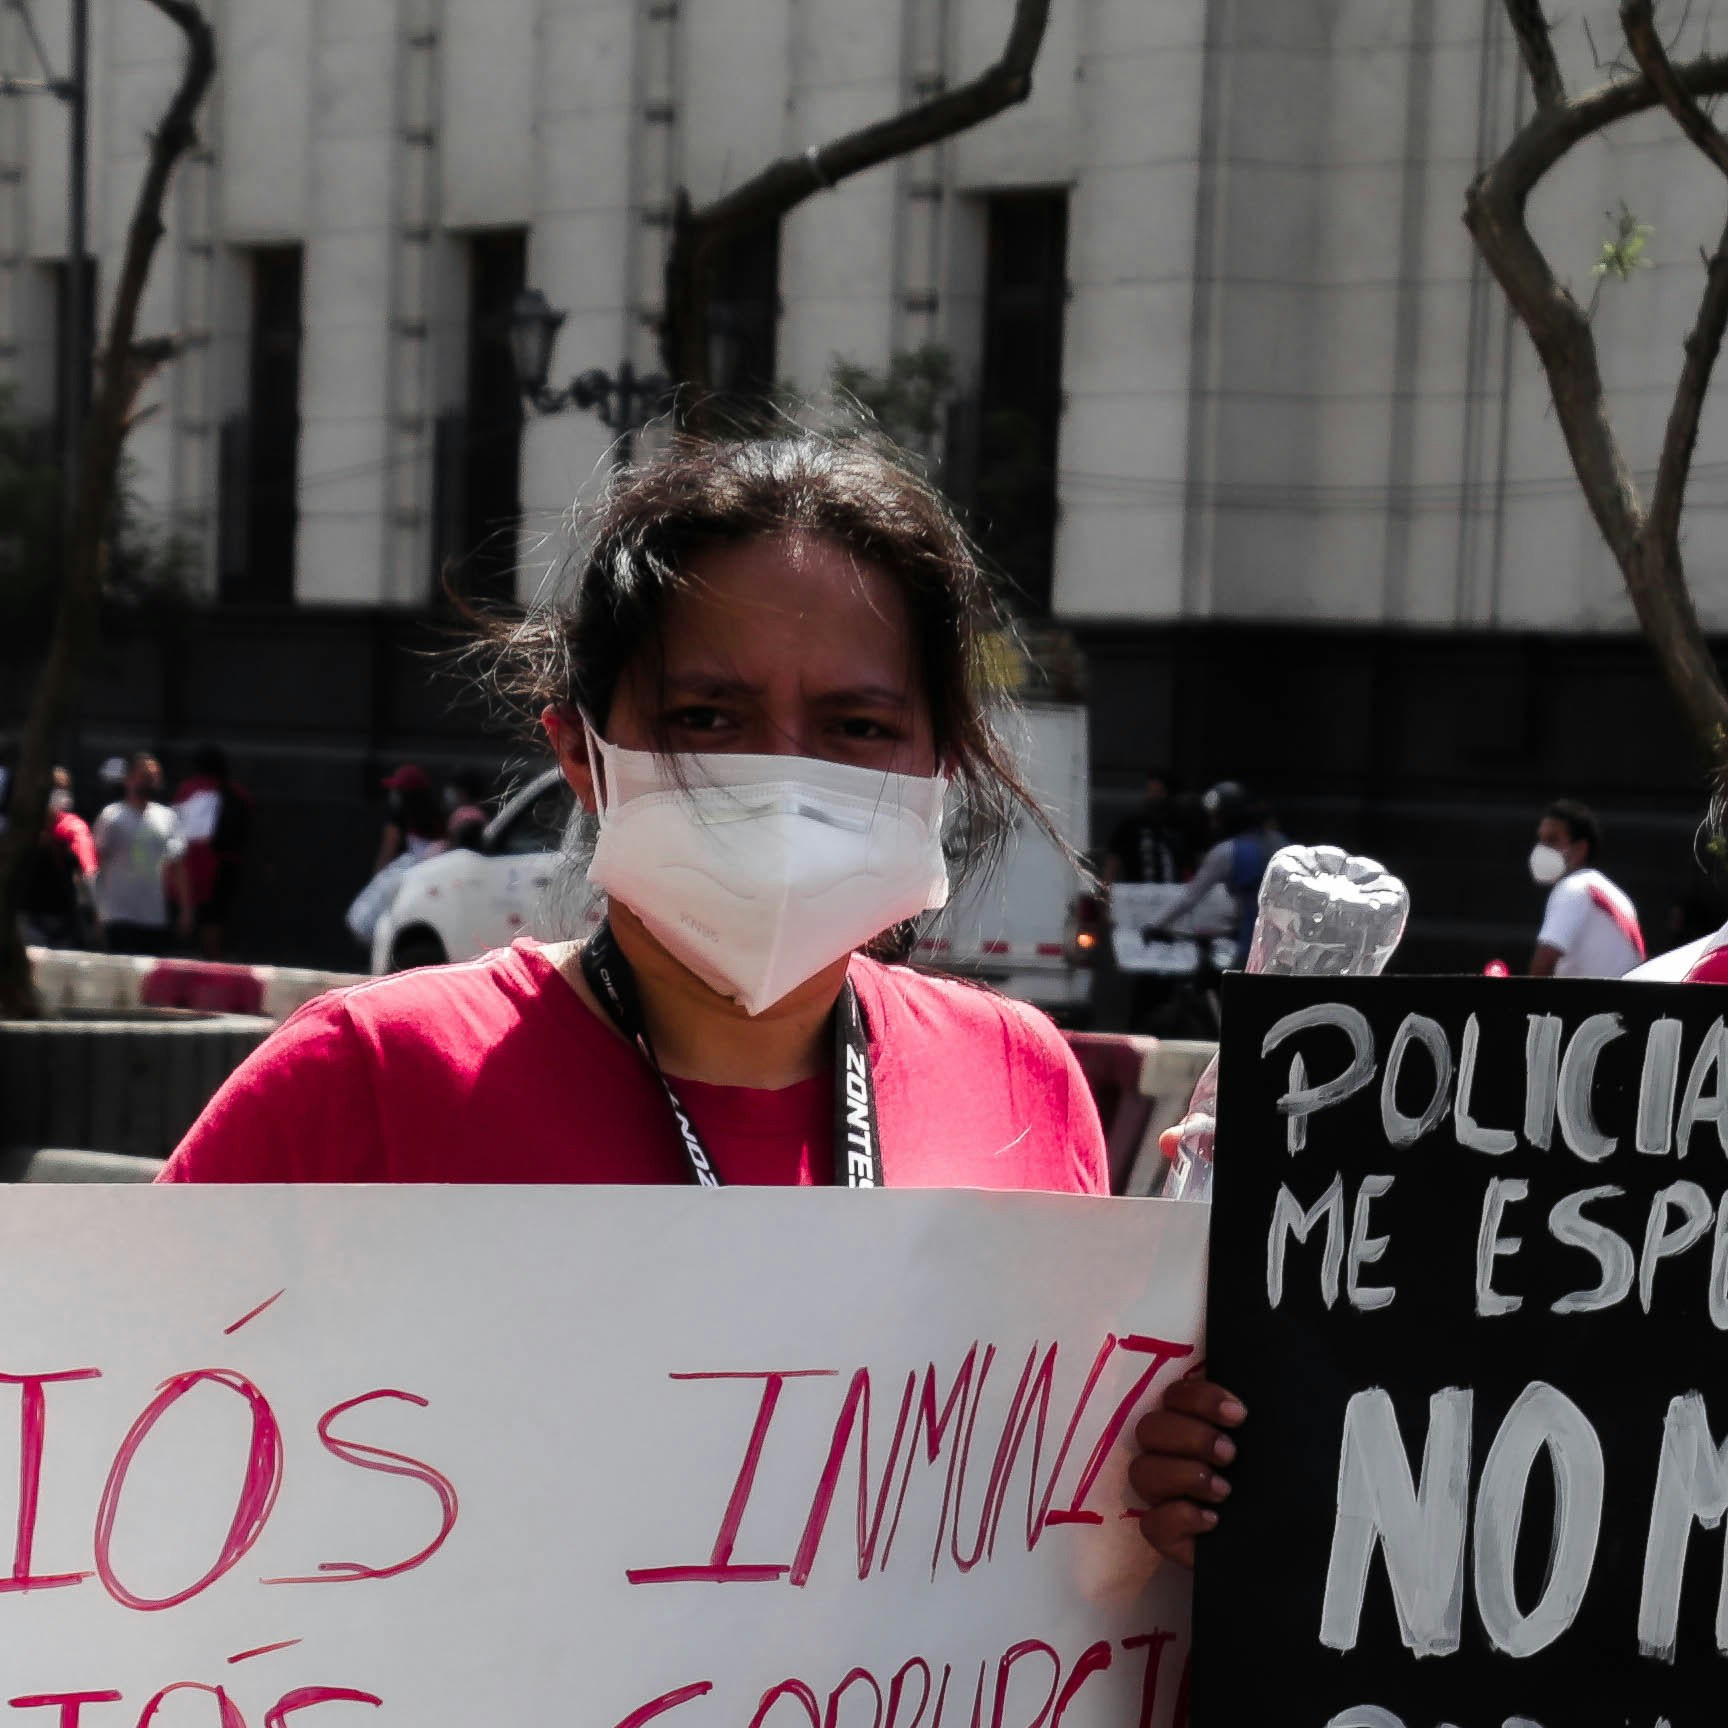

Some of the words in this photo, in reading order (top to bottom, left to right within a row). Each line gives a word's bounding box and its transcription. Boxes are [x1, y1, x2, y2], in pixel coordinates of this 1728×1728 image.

[1268, 1173, 1395, 1310] ME
[626, 1333, 1205, 1588] INMUNI
[1320, 1382, 1603, 1658] NO
